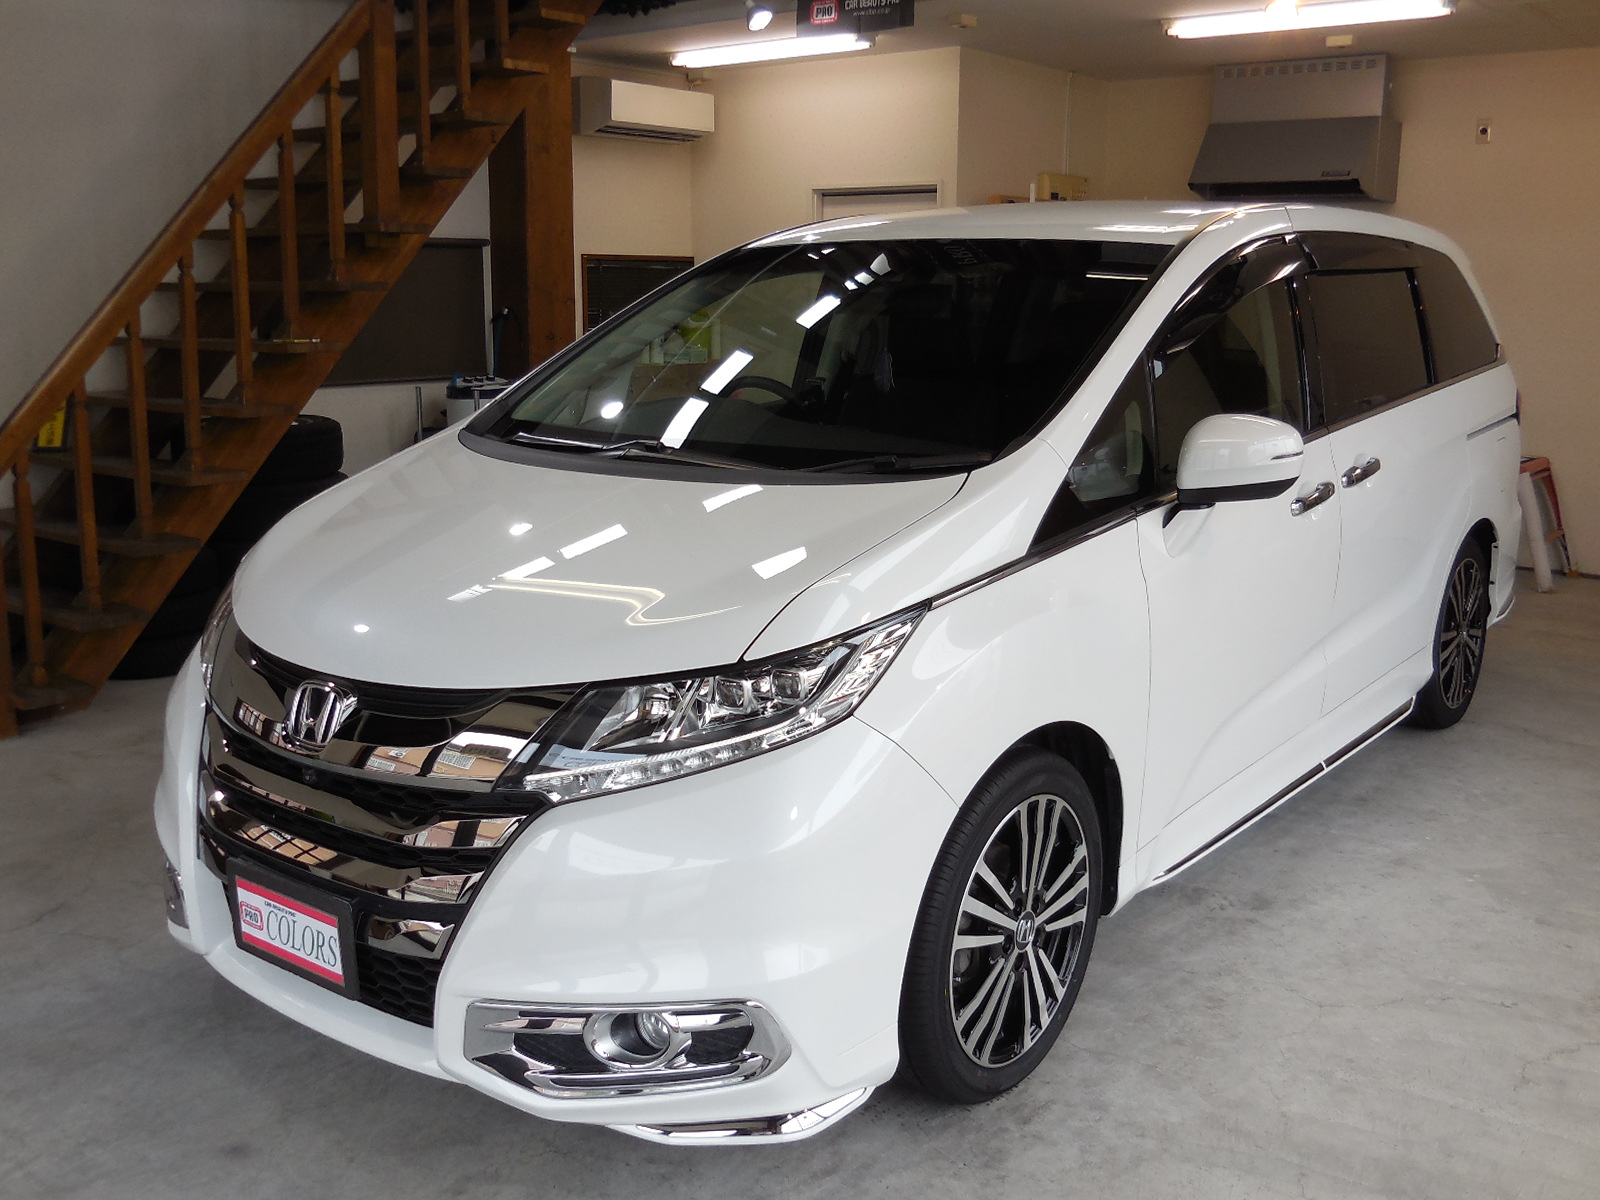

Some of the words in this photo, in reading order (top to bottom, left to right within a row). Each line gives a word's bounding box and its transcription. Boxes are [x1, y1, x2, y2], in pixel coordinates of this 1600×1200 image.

[815, 5, 833, 18] PRO
[244, 907, 259, 924] PRO
[266, 910, 338, 968] COLORS
